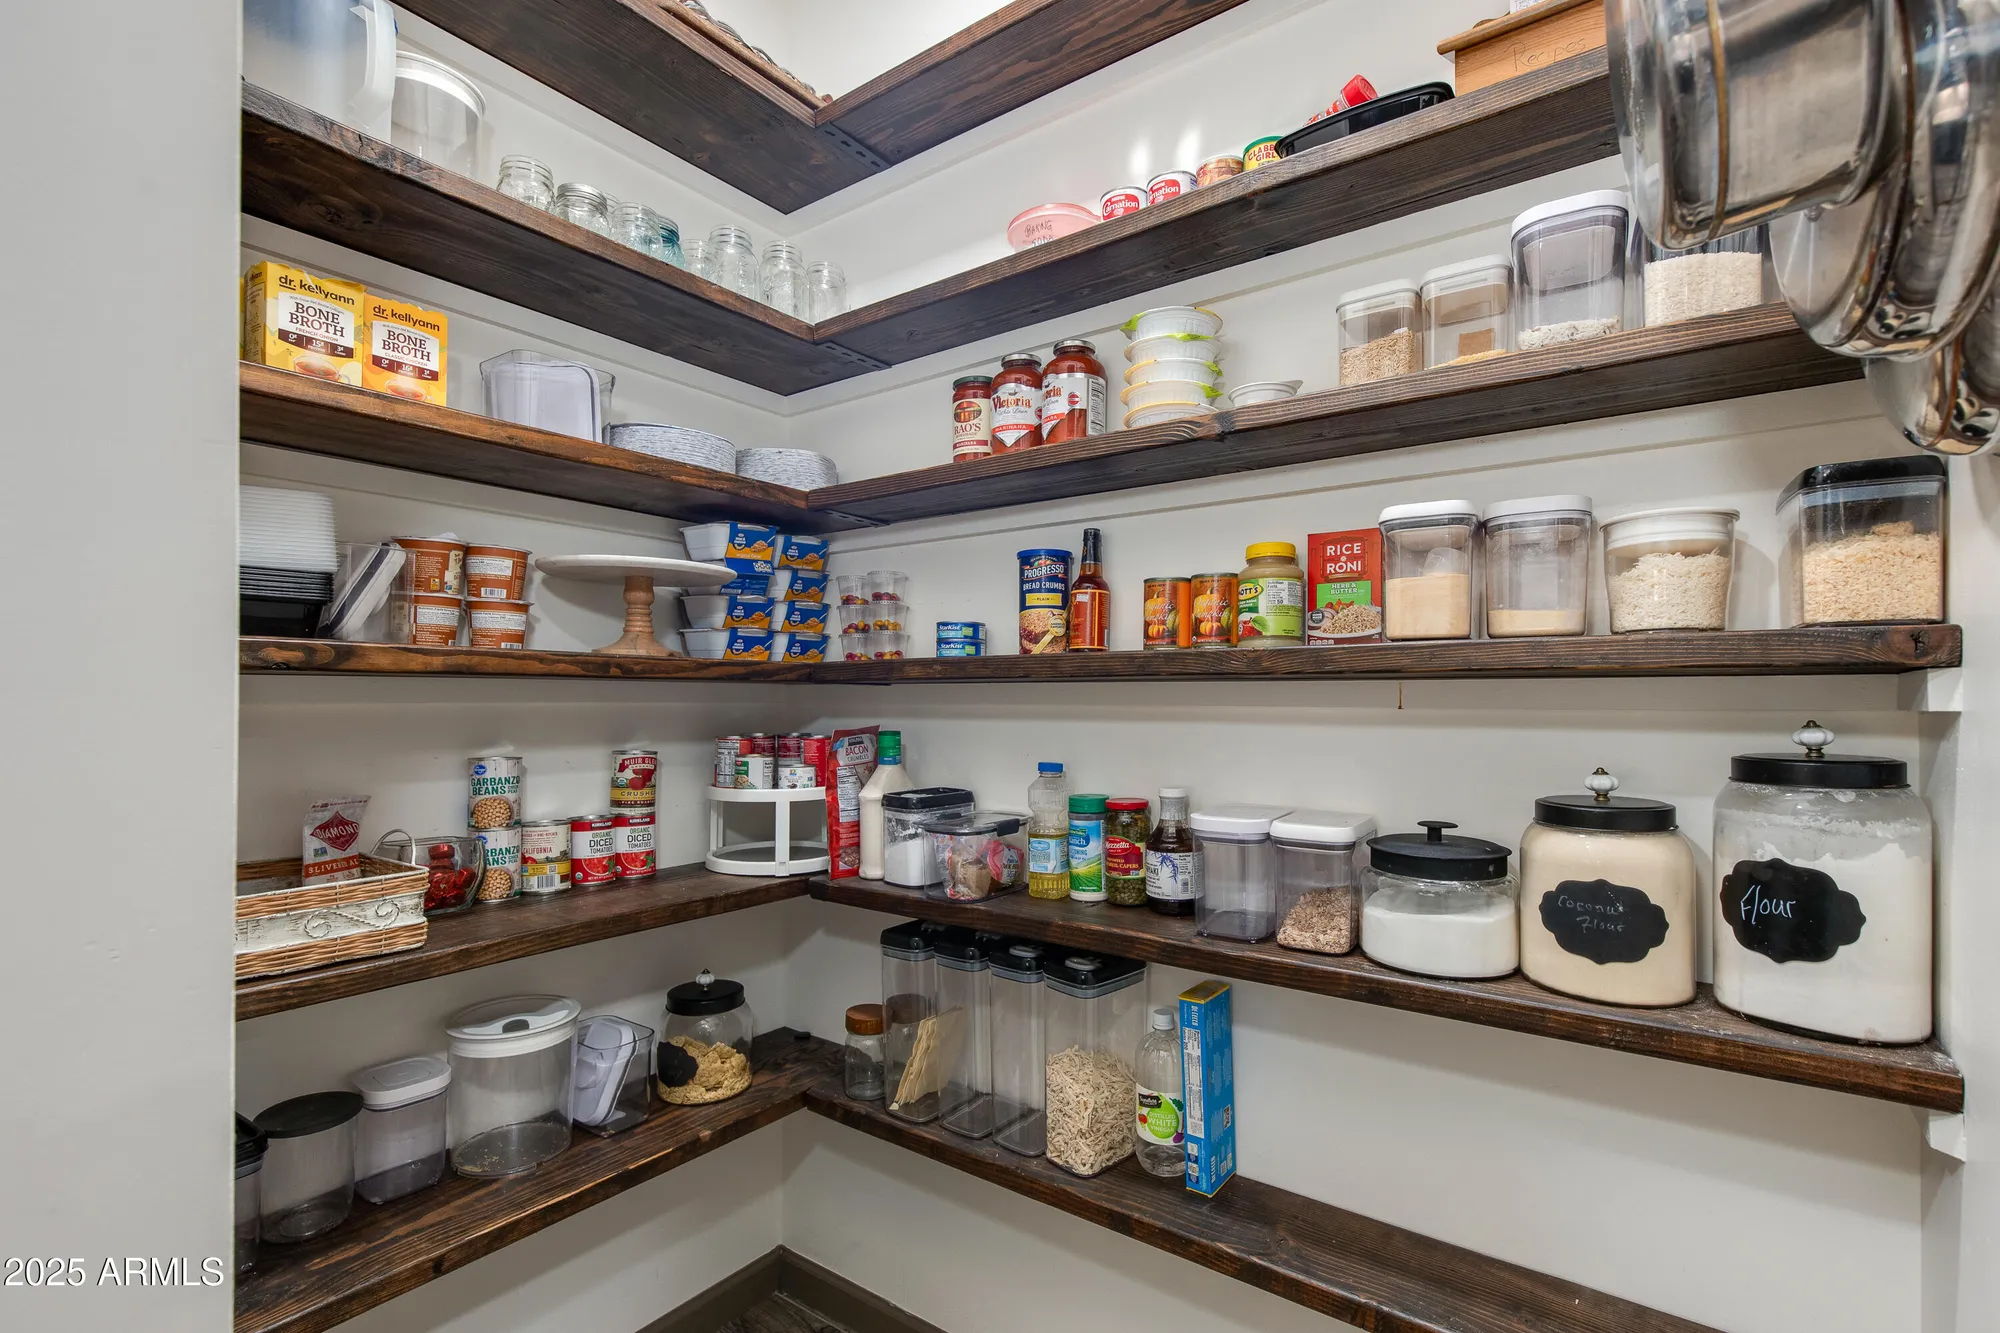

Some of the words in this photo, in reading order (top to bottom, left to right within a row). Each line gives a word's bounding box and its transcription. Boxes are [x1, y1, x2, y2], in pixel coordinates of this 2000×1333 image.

[1503, 38, 1586, 72] Recipes
[1247, 143, 1275, 160] CLABB
[1255, 151, 1276, 162] GIRL
[1103, 200, 1138, 216] Carnation
[1024, 220, 1052, 238] BAKING
[279, 275, 297, 288] dr.
[299, 279, 355, 306] kellyann
[294, 301, 340, 325] BONE
[372, 304, 389, 317] dr.
[391, 308, 440, 332] kellyann
[288, 311, 345, 338] BROTH
[295, 327, 319, 337] FRENCH
[387, 329, 427, 350] BONE
[381, 339, 431, 362] BROTH
[384, 352, 405, 361] CLASSIC
[992, 395, 1032, 412] Victoria
[954, 423, 982, 436] RAO'S
[1326, 543, 1362, 557] RICE
[1024, 564, 1065, 579] PROGRESSO
[1326, 561, 1362, 574] RONI
[1023, 582, 1040, 590] BREAD
[1041, 581, 1065, 590] CRUMBS
[1146, 601, 1175, 611] Organic
[1195, 597, 1229, 609] Organic
[845, 744, 869, 756] BACON
[624, 758, 643, 766] MUIR
[847, 753, 870, 762] CRUMBLES
[471, 775, 520, 787] GARBANZO
[472, 785, 506, 796] BEANS
[316, 823, 360, 839] DIAMOND
[591, 830, 613, 839] ORGANIC
[630, 826, 650, 834] ORGANIC
[589, 837, 614, 848] DICED
[627, 833, 652, 843] DICED
[486, 844, 520, 858] RBANZO
[522, 846, 553, 854] CALIFORNIA
[590, 846, 614, 855] TOMATOES
[628, 841, 652, 849] TOMATOES
[308, 861, 347, 875] SLIVERED
[349, 858, 359, 867] AL
[486, 856, 507, 866] ANS
[1557, 896, 1626, 915] Coconut
[1740, 885, 1796, 925] Flour
[1149, 1117, 1177, 1127] WHITE
